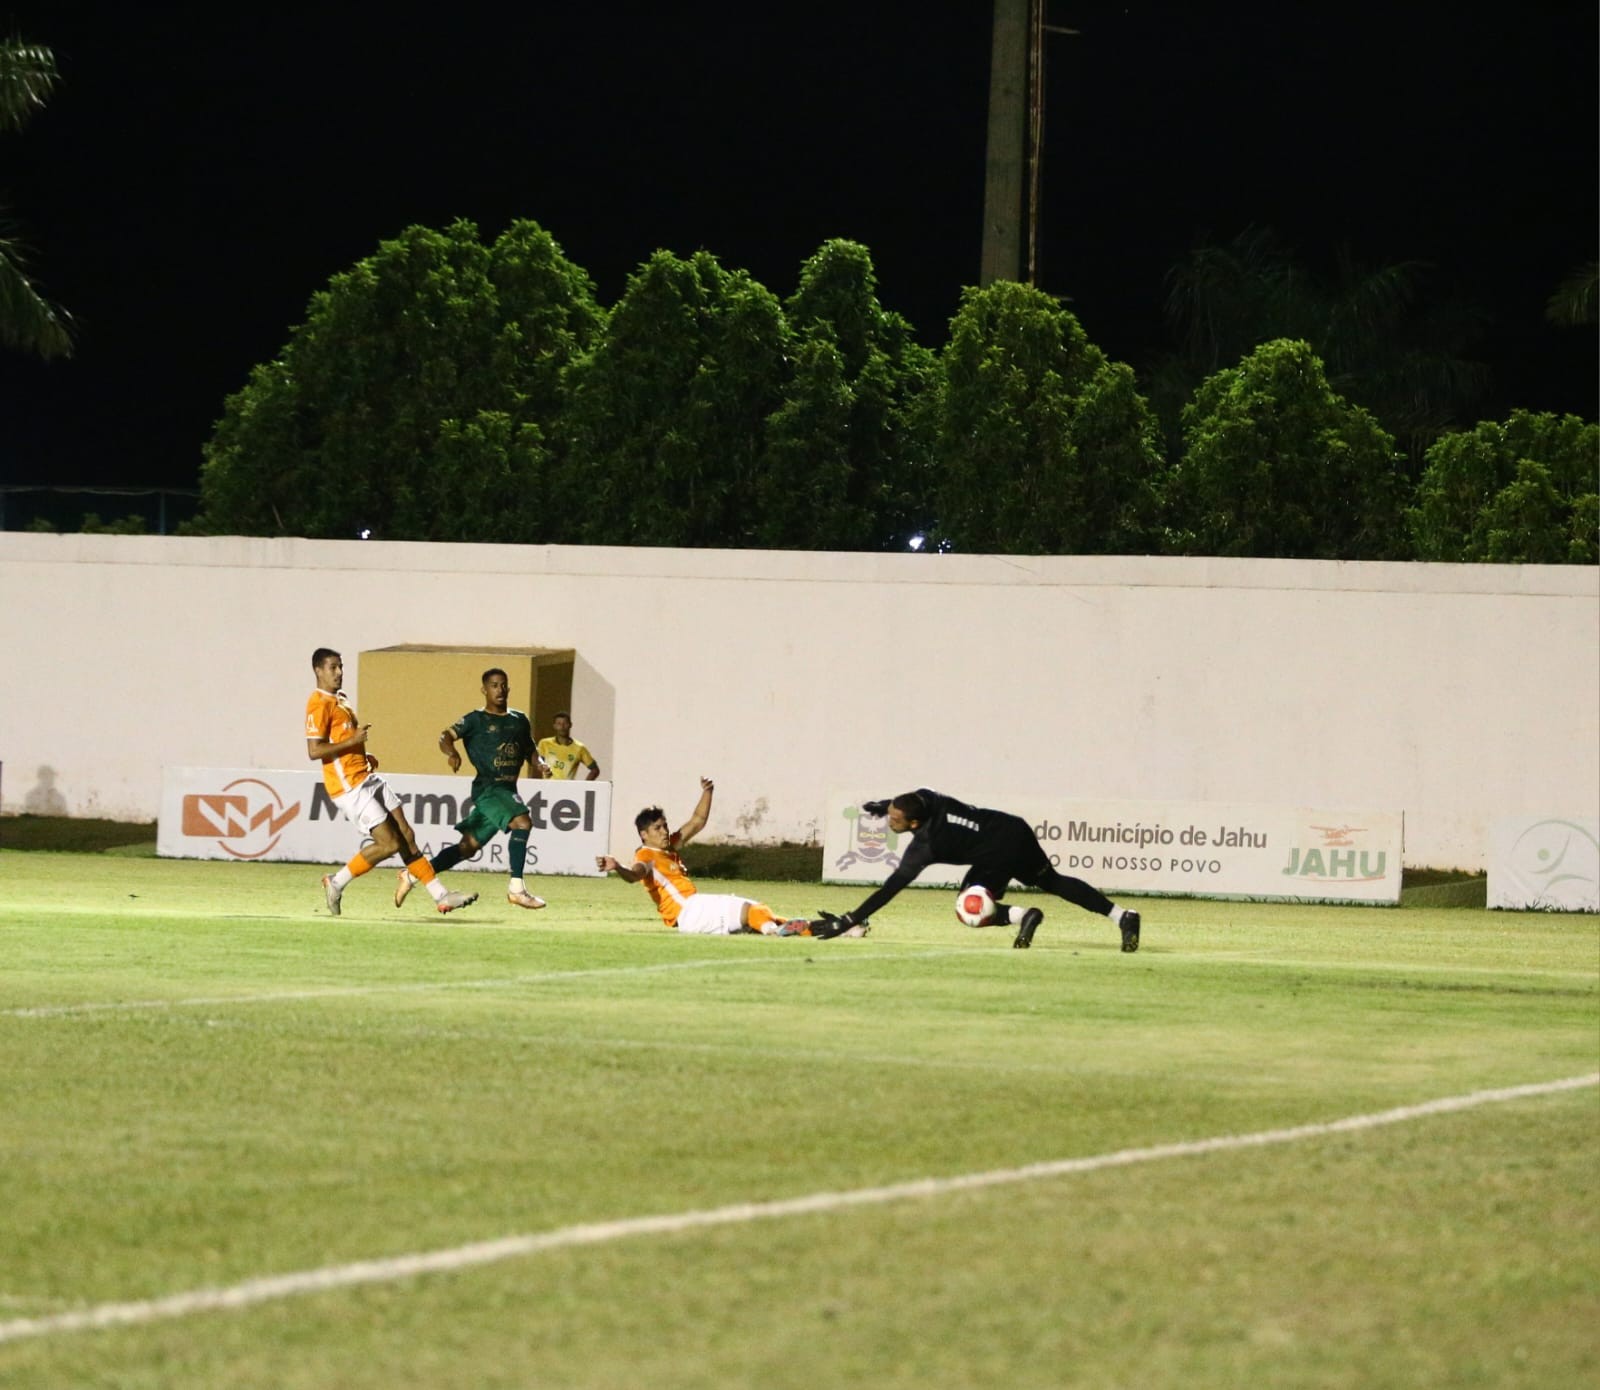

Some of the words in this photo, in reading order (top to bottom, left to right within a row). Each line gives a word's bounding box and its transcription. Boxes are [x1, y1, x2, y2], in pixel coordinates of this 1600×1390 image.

[1034, 820, 1062, 841] do
[1067, 820, 1174, 849] Município
[1180, 825, 1207, 846] de
[1212, 826, 1267, 848] Jahu
[1069, 855, 1094, 869] DO
[1102, 856, 1162, 871] NOSSO
[1171, 858, 1221, 874] POVO
[1282, 848, 1386, 878] JAHU
